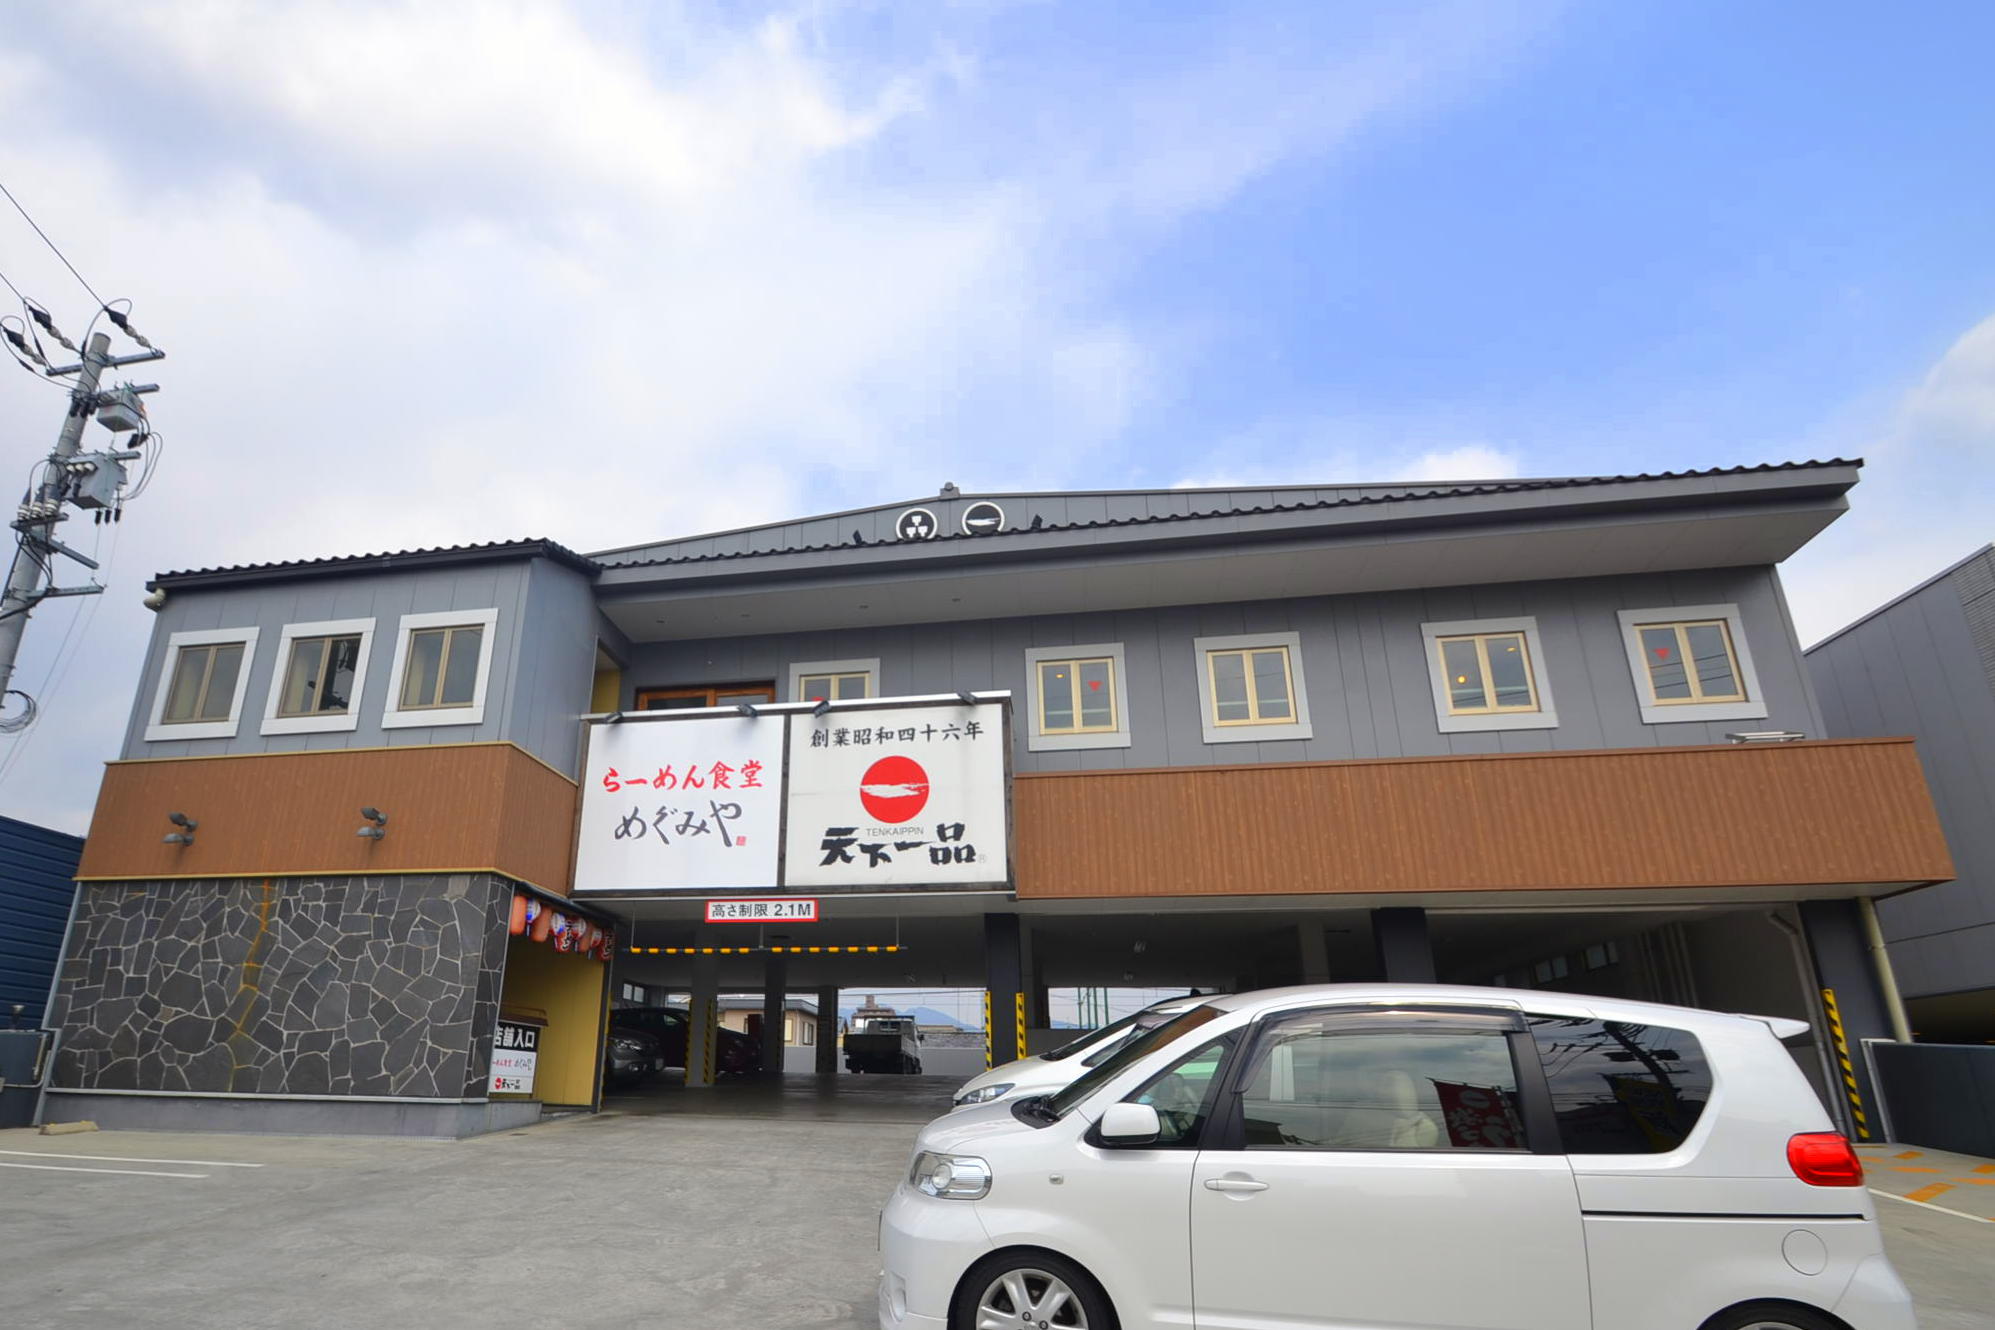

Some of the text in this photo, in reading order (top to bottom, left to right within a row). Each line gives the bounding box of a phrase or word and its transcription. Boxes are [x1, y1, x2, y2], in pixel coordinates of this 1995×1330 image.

[810, 720, 984, 748] 創業昭和四十六年
[603, 759, 764, 793] らーめん食堂
[614, 799, 742, 848] めぐみや
[866, 826, 925, 837] TENKAIPPIN
[819, 822, 977, 869] 天下一品
[712, 903, 811, 917] 高さ制限 2.1M
